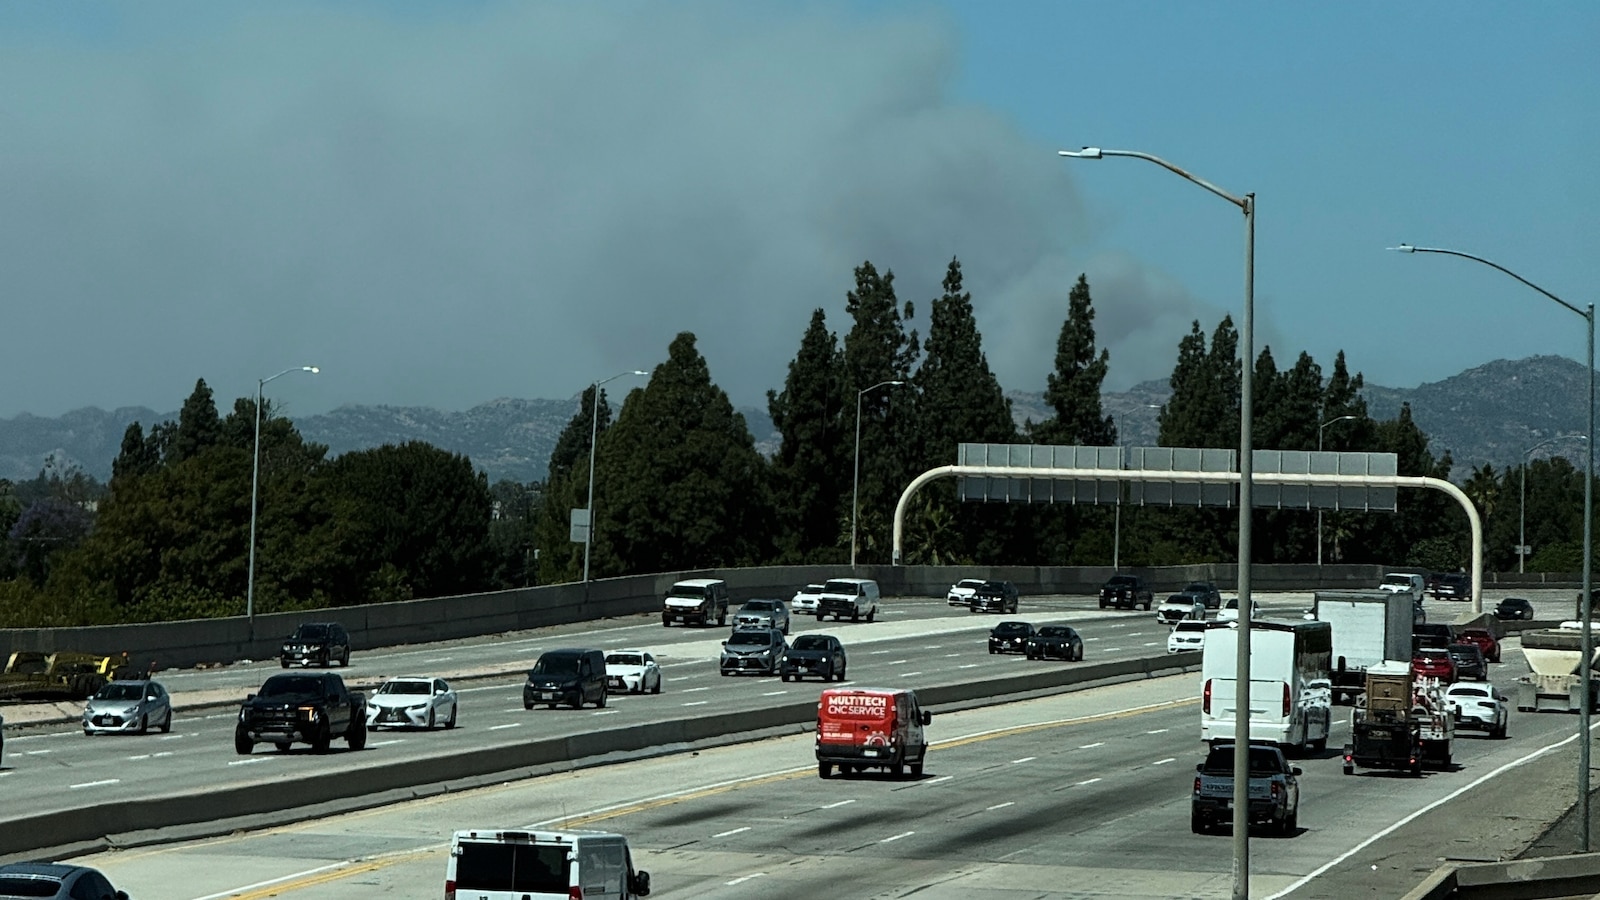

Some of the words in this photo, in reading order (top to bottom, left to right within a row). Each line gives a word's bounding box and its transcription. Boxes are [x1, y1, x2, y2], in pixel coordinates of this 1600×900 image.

[829, 696, 886, 706] MULTITECH
[828, 706, 848, 714] CNC
[849, 706, 885, 715] SERVICE
